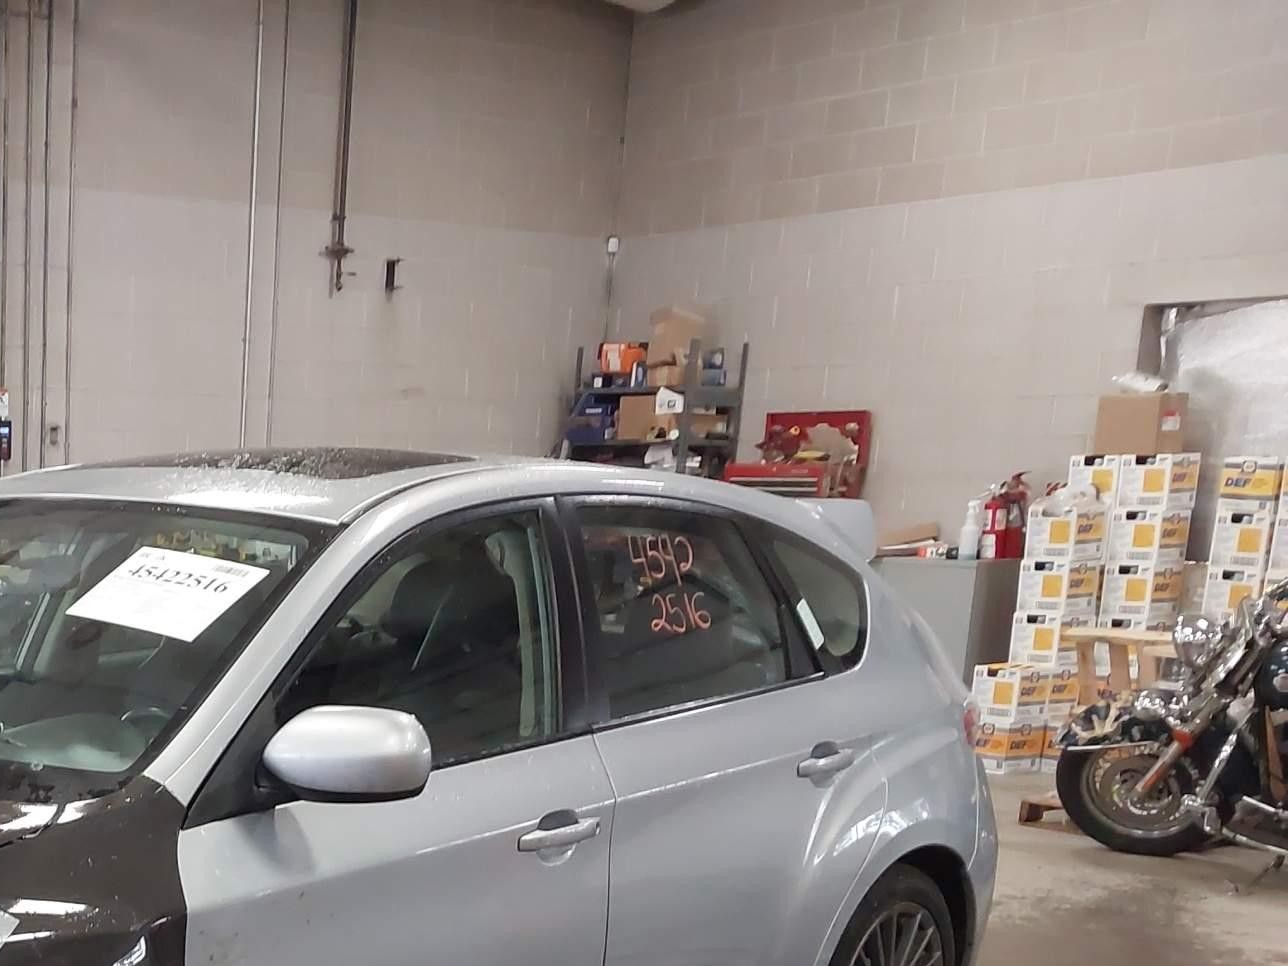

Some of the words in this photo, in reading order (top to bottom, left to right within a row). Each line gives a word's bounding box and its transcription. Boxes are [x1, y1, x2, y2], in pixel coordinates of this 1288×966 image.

[1224, 476, 1252, 488] DEF
[128, 563, 230, 593] 45422516
[651, 591, 712, 633] 2516
